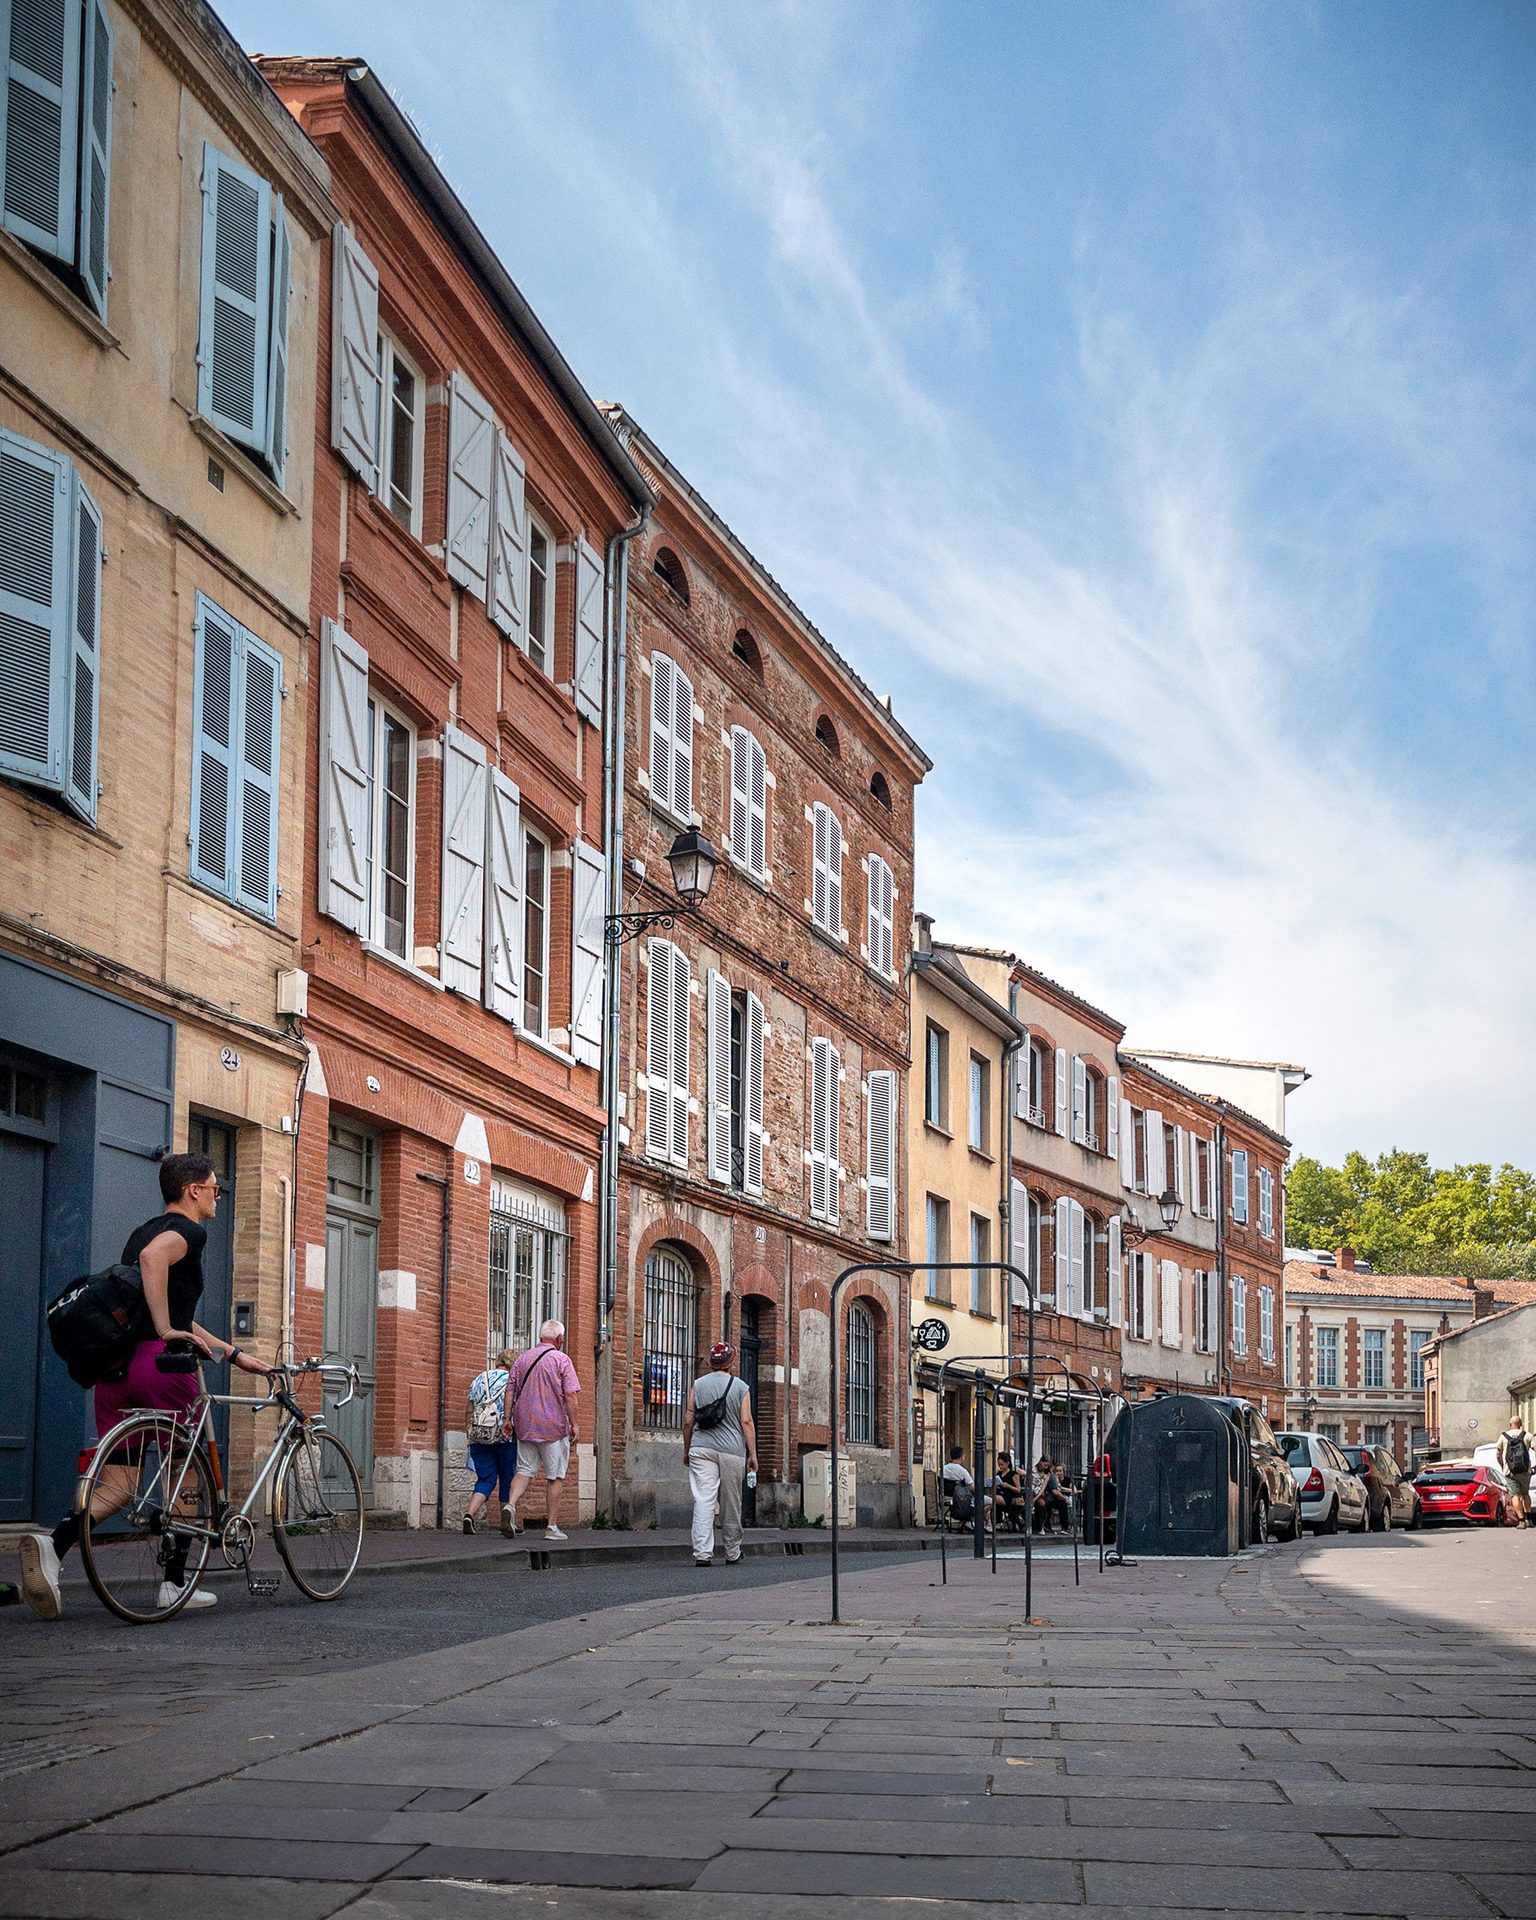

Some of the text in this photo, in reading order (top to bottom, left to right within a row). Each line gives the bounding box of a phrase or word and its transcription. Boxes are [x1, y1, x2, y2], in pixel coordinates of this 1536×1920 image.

[224, 1048, 238, 1067] 24
[465, 1161, 480, 1181] 22
[757, 1227, 766, 1241] 20
